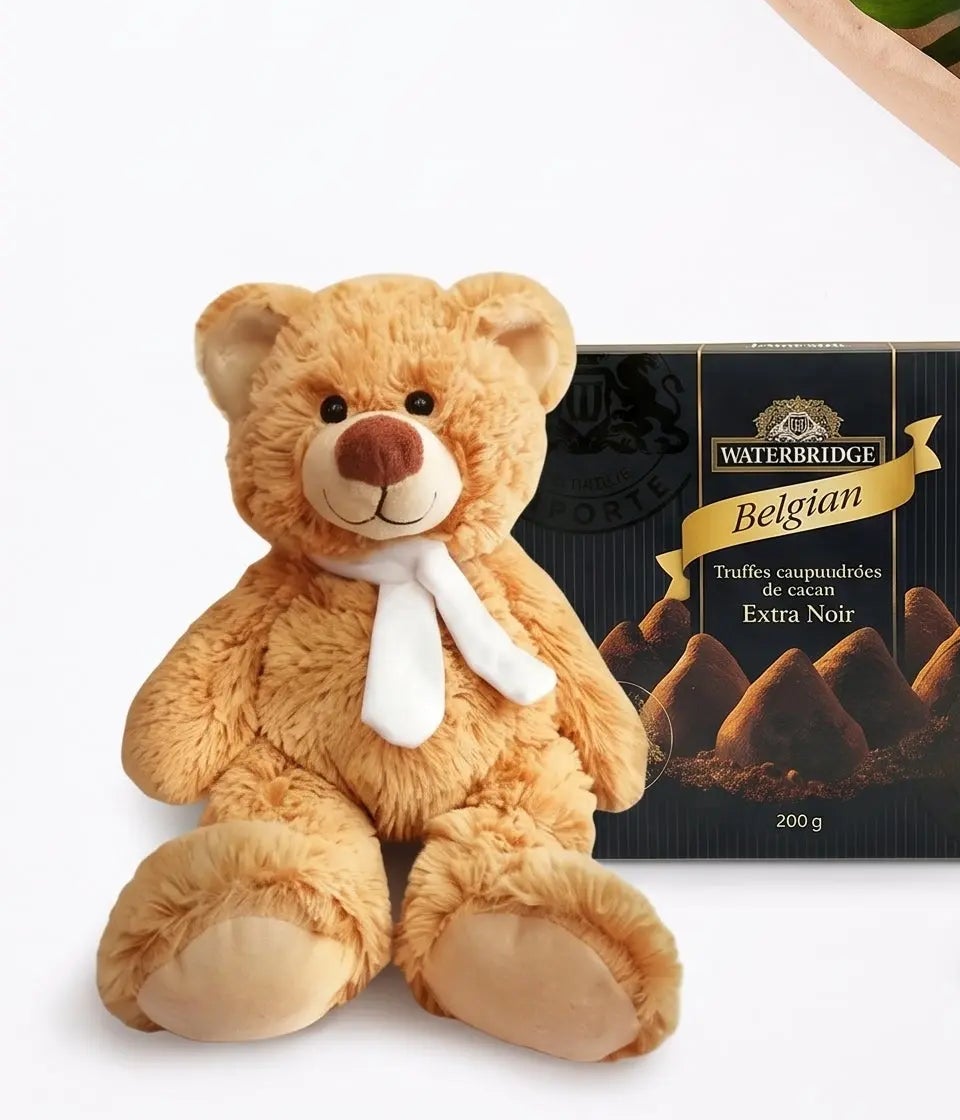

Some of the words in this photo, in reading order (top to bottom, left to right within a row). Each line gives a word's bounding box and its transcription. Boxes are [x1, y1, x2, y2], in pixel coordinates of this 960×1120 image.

[720, 446, 876, 465] WATERBRIDGE
[731, 484, 863, 532] Belgian
[713, 563, 771, 579] Truffes
[762, 582, 782, 596] de
[787, 586, 835, 596] cacan
[742, 604, 801, 623] Extra
[806, 604, 856, 623] Noir
[776, 813, 808, 828] 200
[811, 817, 823, 833] g
